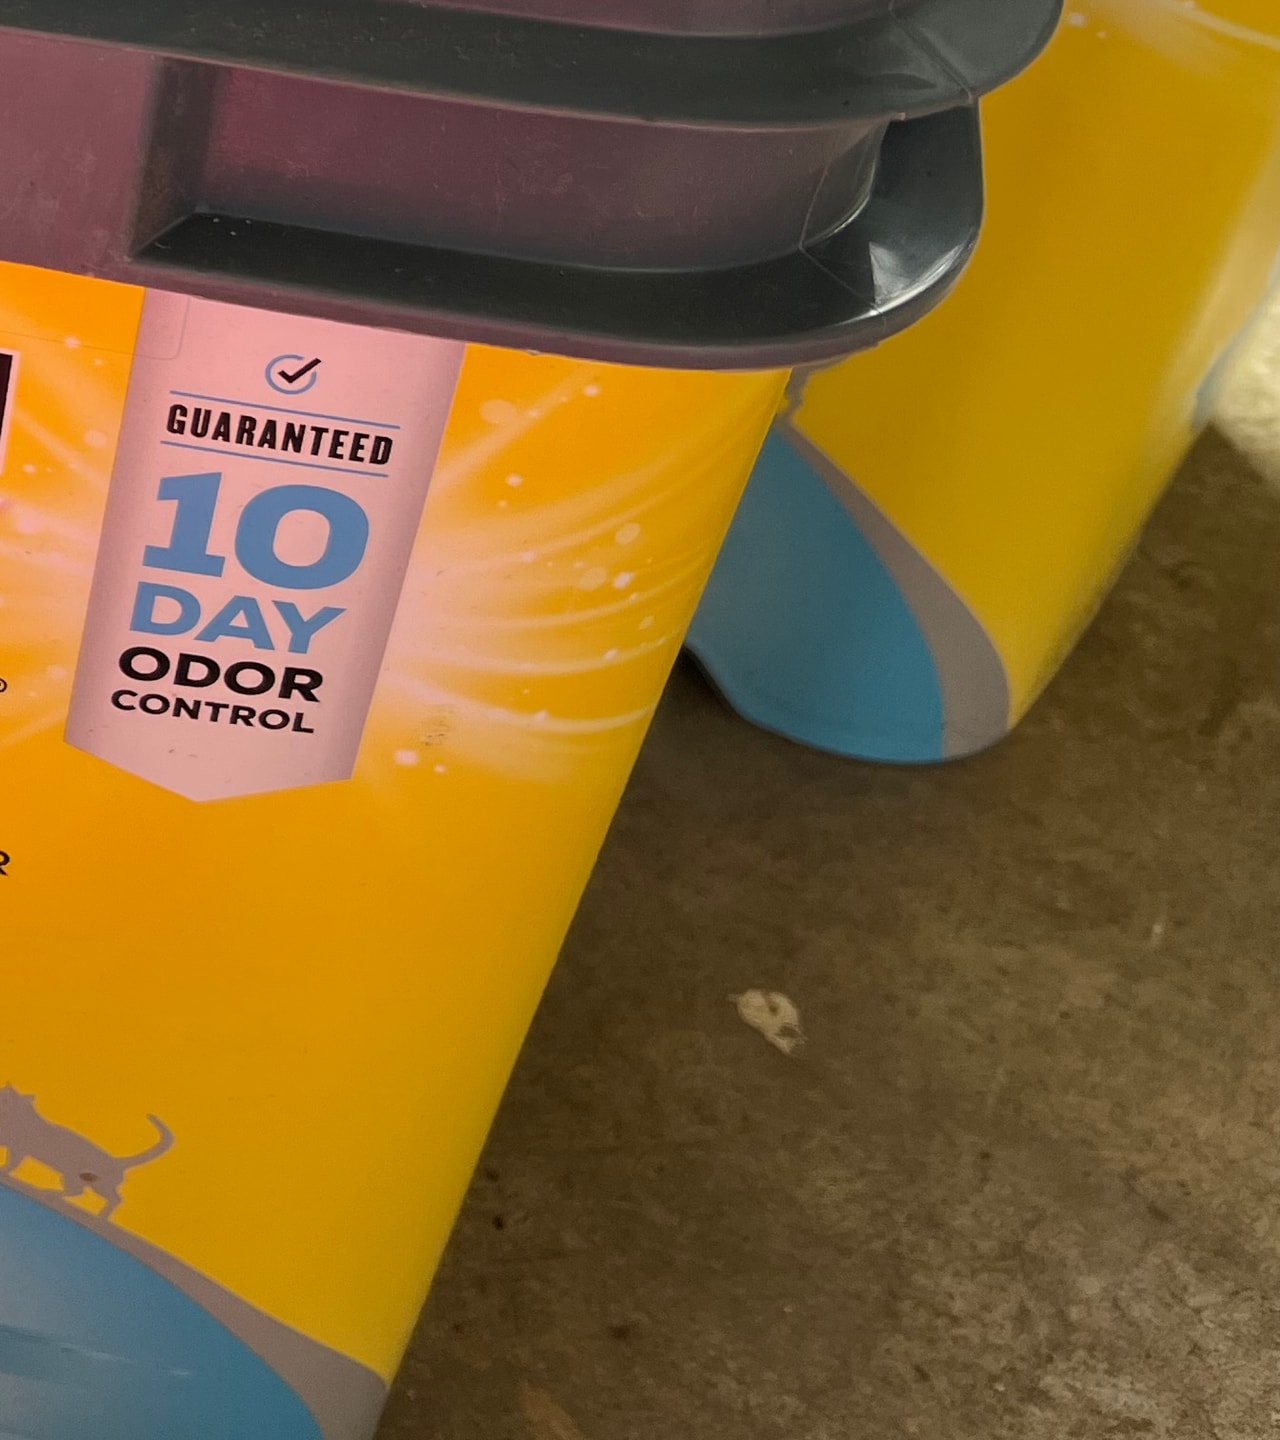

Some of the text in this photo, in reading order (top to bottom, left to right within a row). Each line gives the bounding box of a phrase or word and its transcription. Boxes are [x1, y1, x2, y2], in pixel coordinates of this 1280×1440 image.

[166, 404, 393, 466] GUARANTEED
[142, 472, 370, 590] 10
[129, 581, 347, 655] DAY
[118, 646, 324, 703] ODOR
[111, 688, 315, 734] CONTROL
